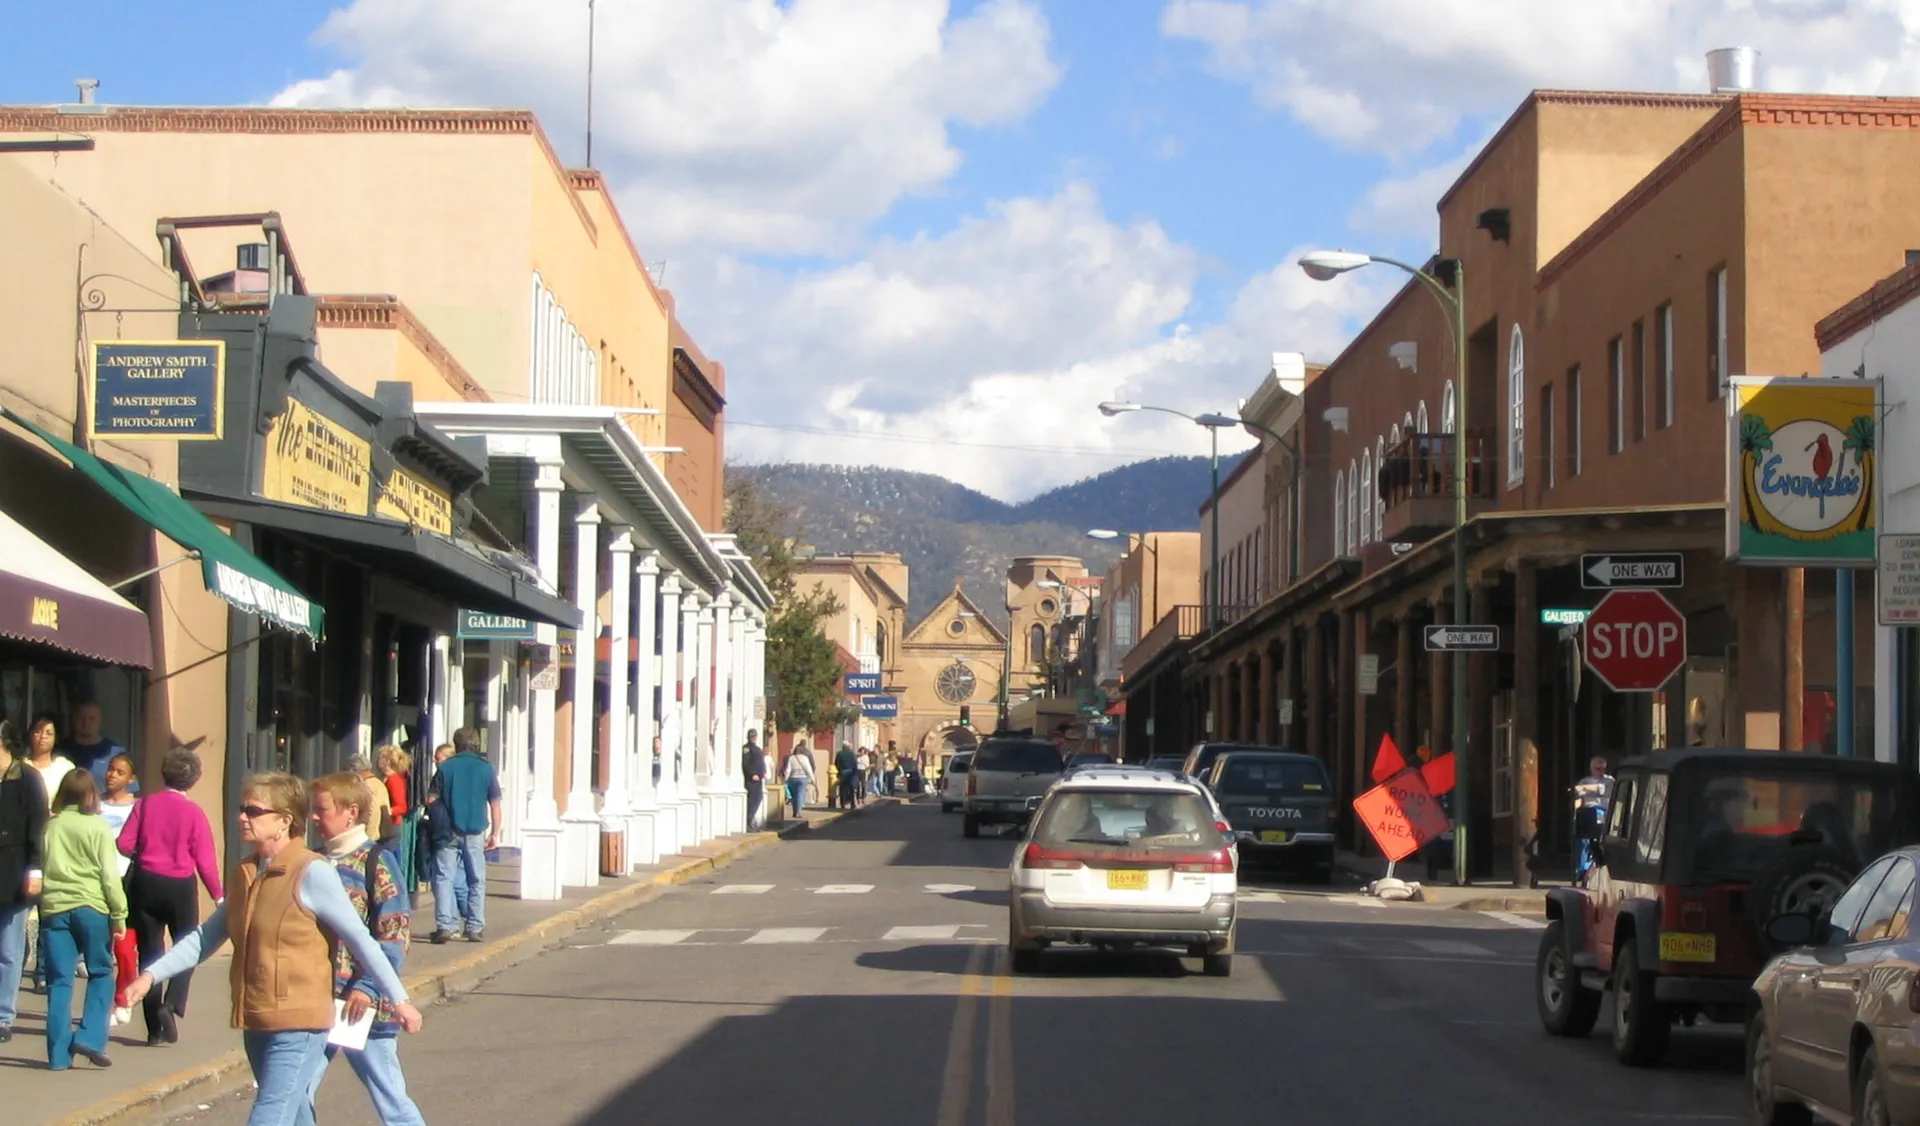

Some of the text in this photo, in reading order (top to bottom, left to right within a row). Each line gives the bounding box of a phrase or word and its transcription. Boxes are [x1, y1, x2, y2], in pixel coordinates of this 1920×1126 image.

[107, 356, 208, 367] ANDREW SMITH
[127, 368, 186, 379] GALLERY
[112, 396, 197, 406] MASTERPIECES
[112, 417, 197, 428] PHOTOGRAPHY
[1612, 564, 1671, 577] ONE WAY
[468, 616, 527, 629] GALLERY
[1544, 611, 1585, 623] GALISTEO
[1447, 633, 1490, 643] ONE WAY
[1592, 622, 1678, 659] STOP
[848, 678, 876, 689] SPIRIT
[1248, 807, 1302, 819] TOYOTA
